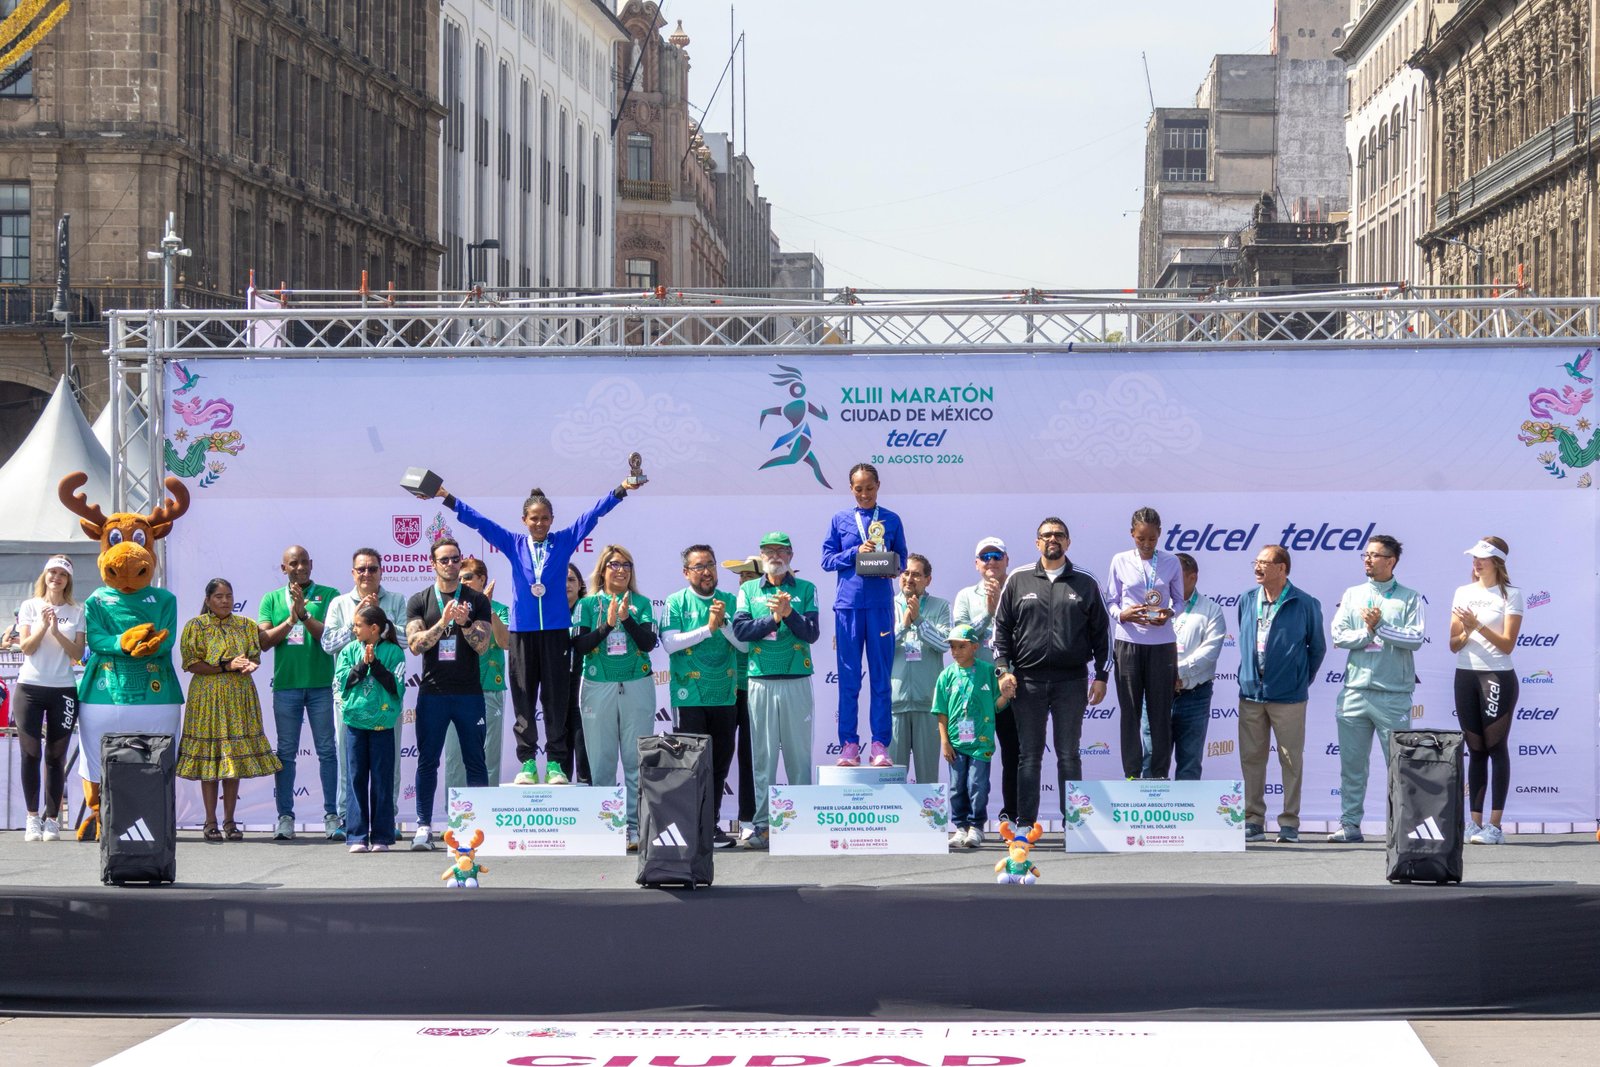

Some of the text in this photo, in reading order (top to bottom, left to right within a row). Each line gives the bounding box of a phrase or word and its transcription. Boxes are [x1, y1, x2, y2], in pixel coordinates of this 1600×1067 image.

[840, 382, 993, 404] XLIII MARATÓN
[840, 405, 993, 422] CIUDAD DE MÉXICO
[886, 429, 947, 447] telcel
[871, 454, 964, 464] 30 AGOSTO 2026
[1164, 522, 1376, 551] telcel telcel
[1517, 634, 1559, 646] telcel
[1485, 680, 1500, 718] telcel
[62, 695, 74, 729] telcel
[1084, 707, 1116, 719] elcel
[1210, 708, 1239, 719] BVA
[1517, 708, 1559, 720] telcel
[1519, 745, 1556, 756] BBVA
[496, 814, 576, 828] $20,000 USD
[817, 812, 899, 826] $50,000 USD
[1113, 810, 1194, 824] $10,000 USD
[506, 1054, 1026, 1066] CIUDAD
